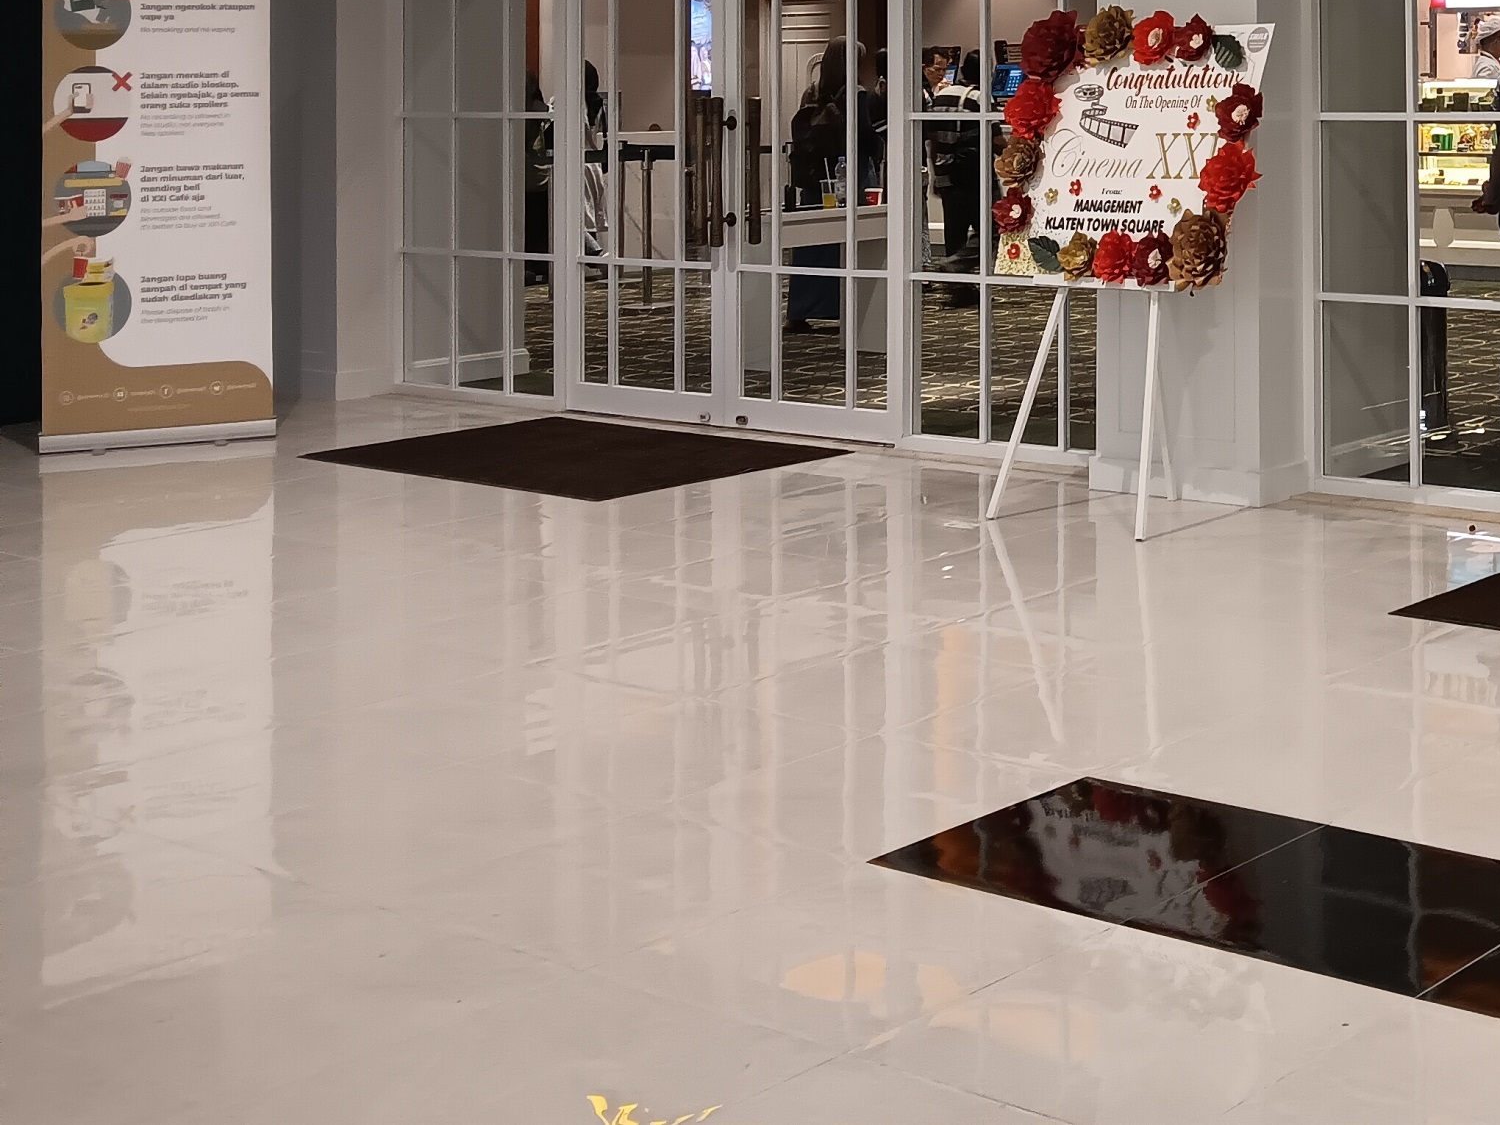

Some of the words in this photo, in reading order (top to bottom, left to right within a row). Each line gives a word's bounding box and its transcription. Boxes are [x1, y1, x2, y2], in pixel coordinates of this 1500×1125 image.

[140, 72, 174, 81] Jangan
[1125, 96, 1137, 109] On
[1139, 95, 1153, 109] The
[1155, 95, 1189, 113] Opening
[1191, 94, 1203, 109] Of
[1051, 128, 1143, 179] Cinema
[140, 165, 174, 174] Jangan
[1073, 199, 1143, 214] MANAGEMENT
[1045, 216, 1085, 231] KLATEN
[1087, 218, 1119, 232] TOWN
[1120, 218, 1165, 233] SQUARE
[140, 275, 174, 284] Jangan
